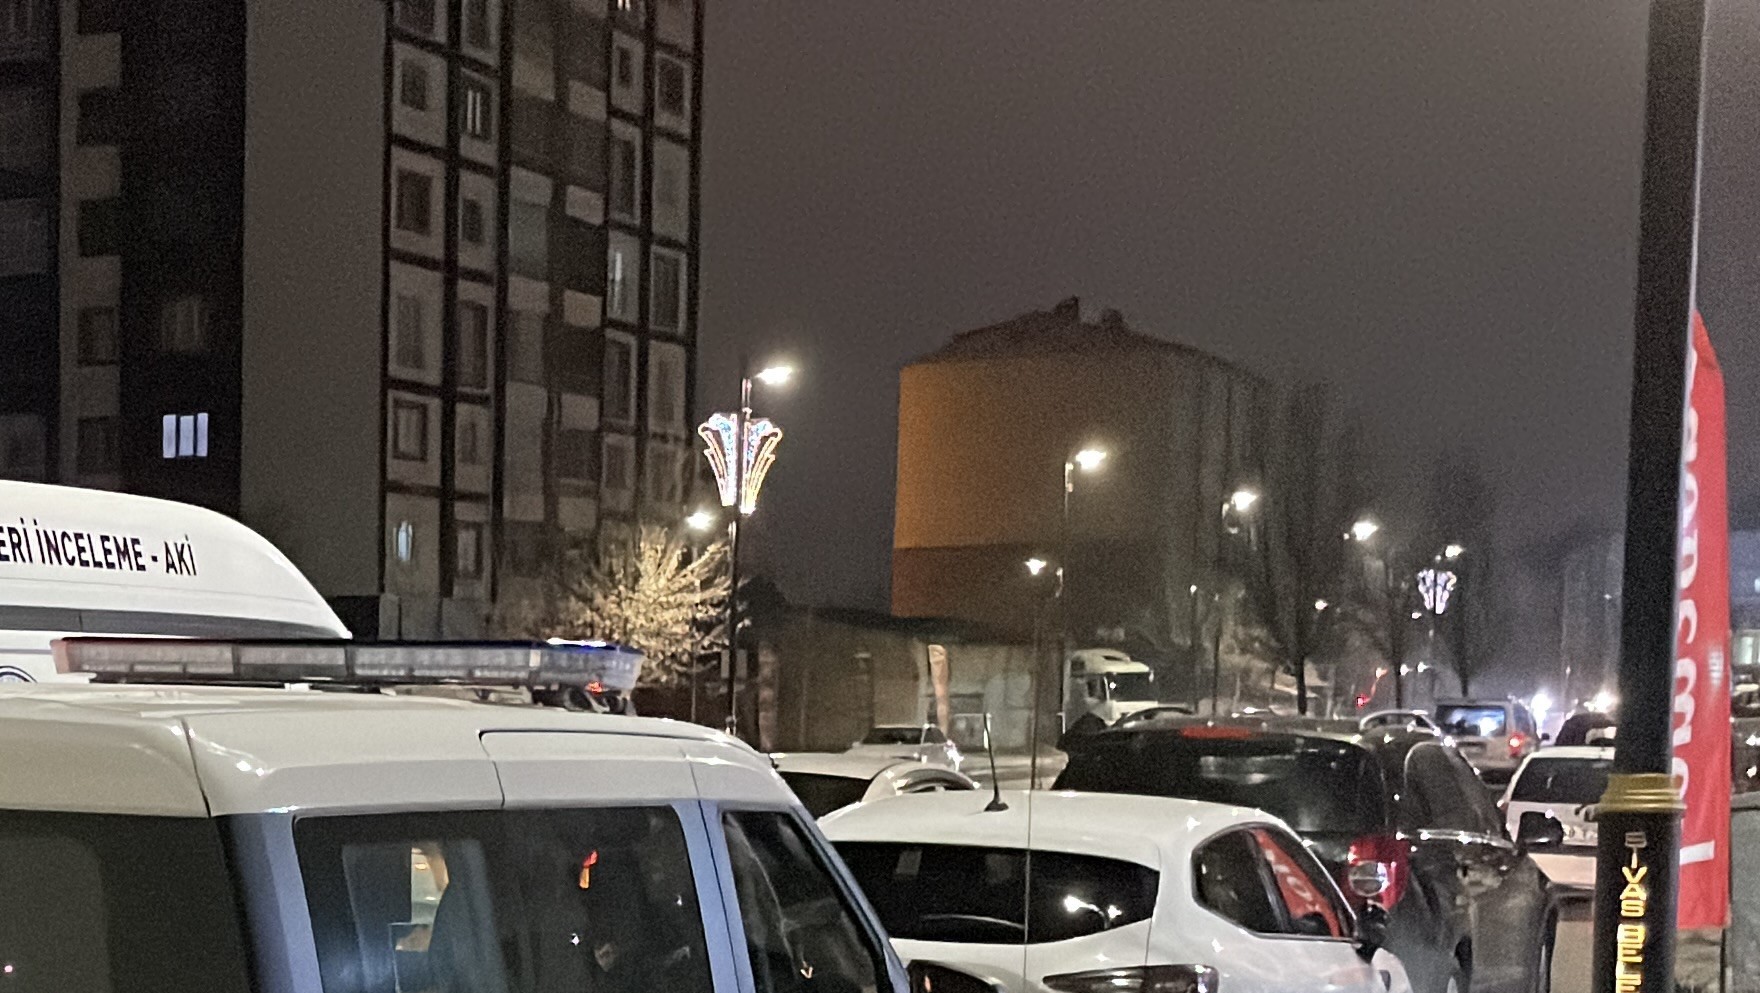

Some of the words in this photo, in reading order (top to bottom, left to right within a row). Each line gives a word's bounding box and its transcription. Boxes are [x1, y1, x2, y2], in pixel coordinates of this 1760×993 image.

[33, 519, 146, 571] İNCELEME
[151, 554, 159, 563] -
[164, 533, 198, 576] AKİ
